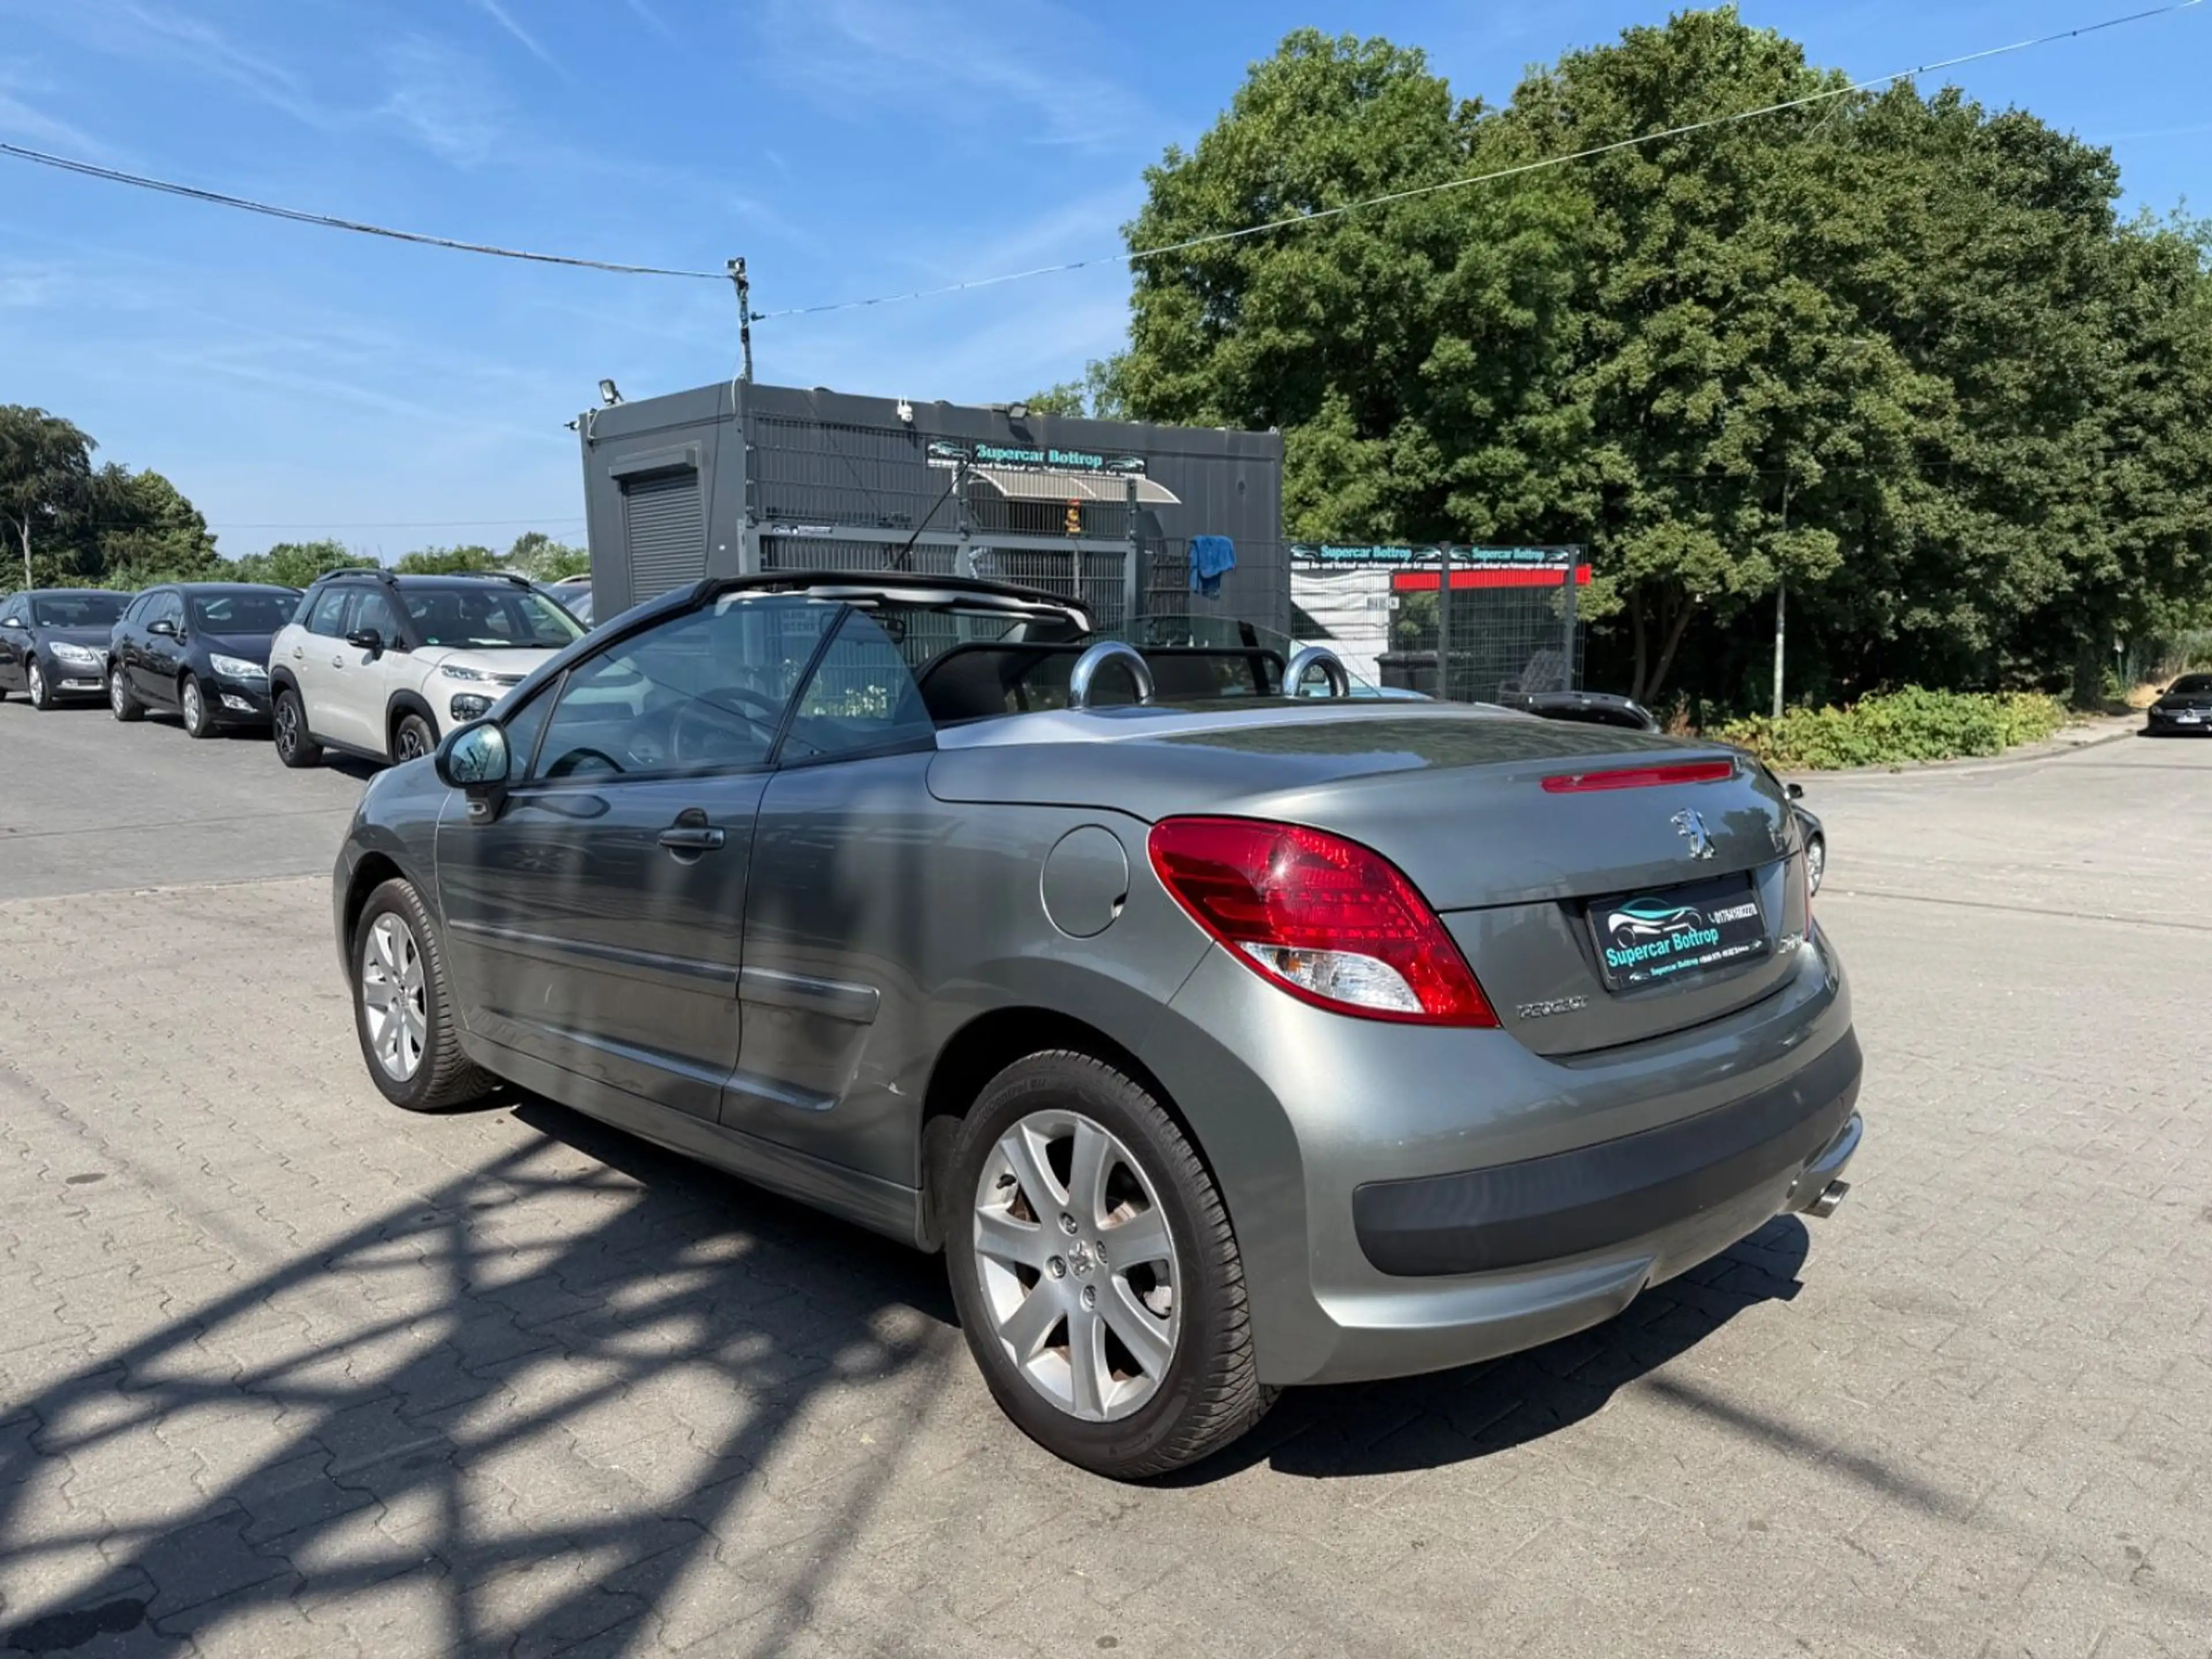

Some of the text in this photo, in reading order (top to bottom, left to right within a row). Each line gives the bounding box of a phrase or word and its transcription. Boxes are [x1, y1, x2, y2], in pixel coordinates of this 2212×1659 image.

[976, 444, 1103, 467] Supercar Bottrop
[1320, 545, 1412, 562] Supercar Bottrop
[1605, 939, 1670, 967] Supercar
[1671, 928, 1719, 950] Bottrop
